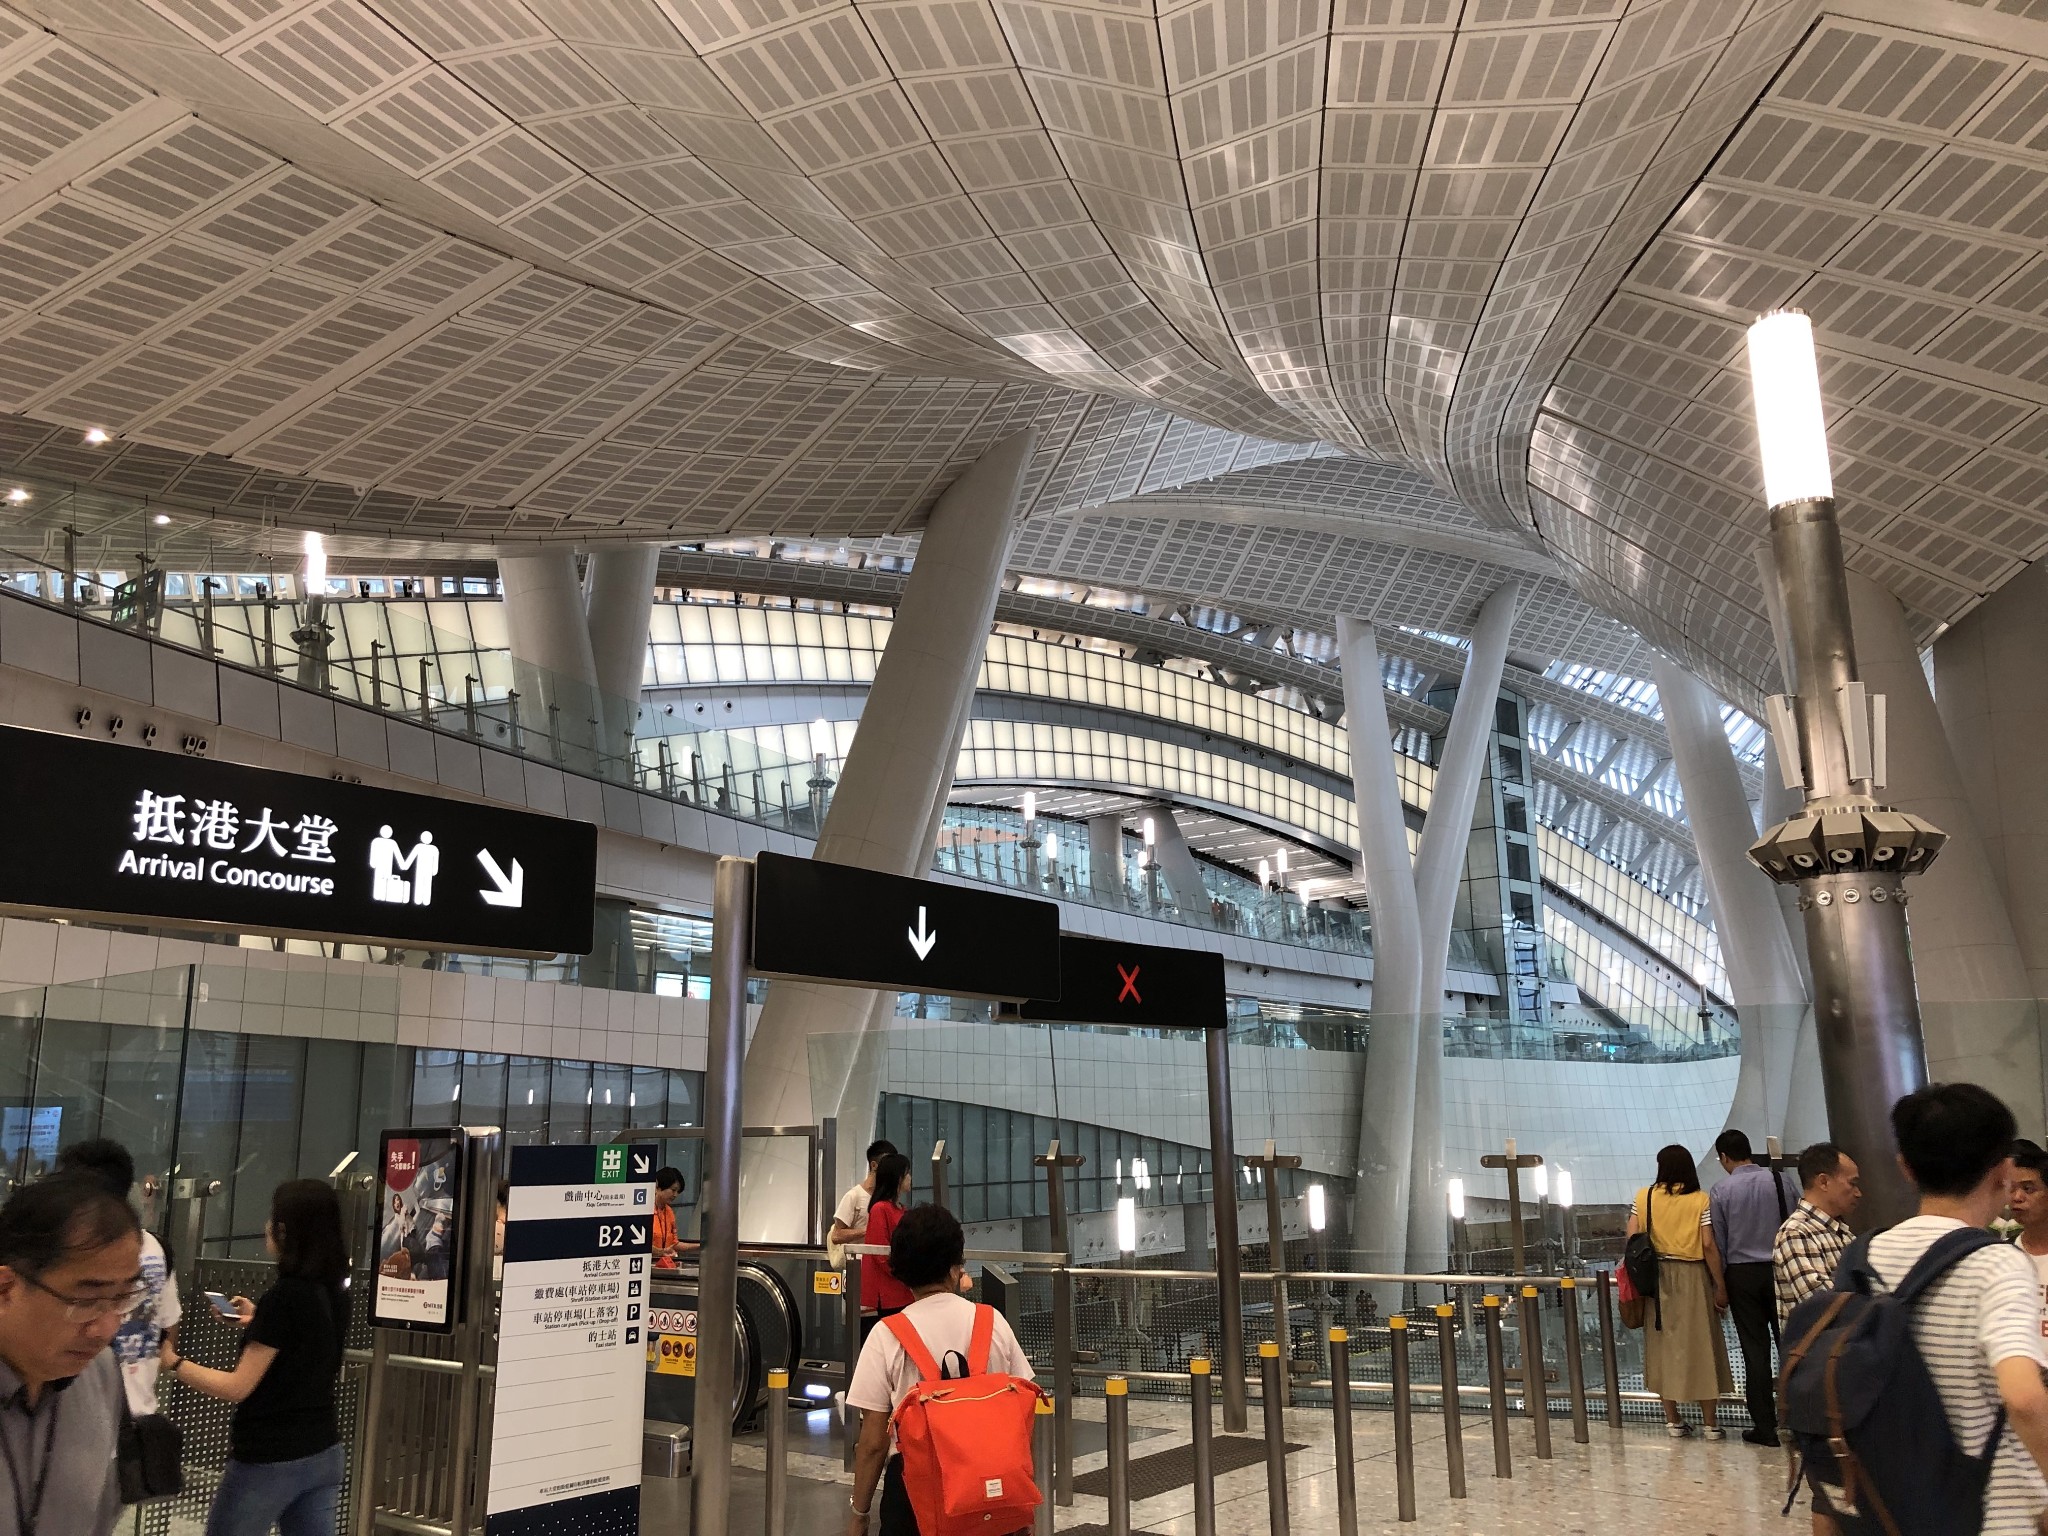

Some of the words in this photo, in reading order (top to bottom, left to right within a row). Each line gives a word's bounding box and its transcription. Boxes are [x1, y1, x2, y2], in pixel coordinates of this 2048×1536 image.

[132, 789, 339, 863] 抵港大堂
[118, 849, 205, 881] Arrival
[210, 860, 335, 895] Concourse
[602, 1149, 621, 1170] 出
[601, 1170, 620, 1178] EXIT
[636, 1191, 645, 1203] G
[598, 1225, 624, 1247] B2
[583, 1258, 620, 1273] 抵港大堂
[630, 1305, 638, 1319] P
[588, 1328, 617, 1343] 的士站
